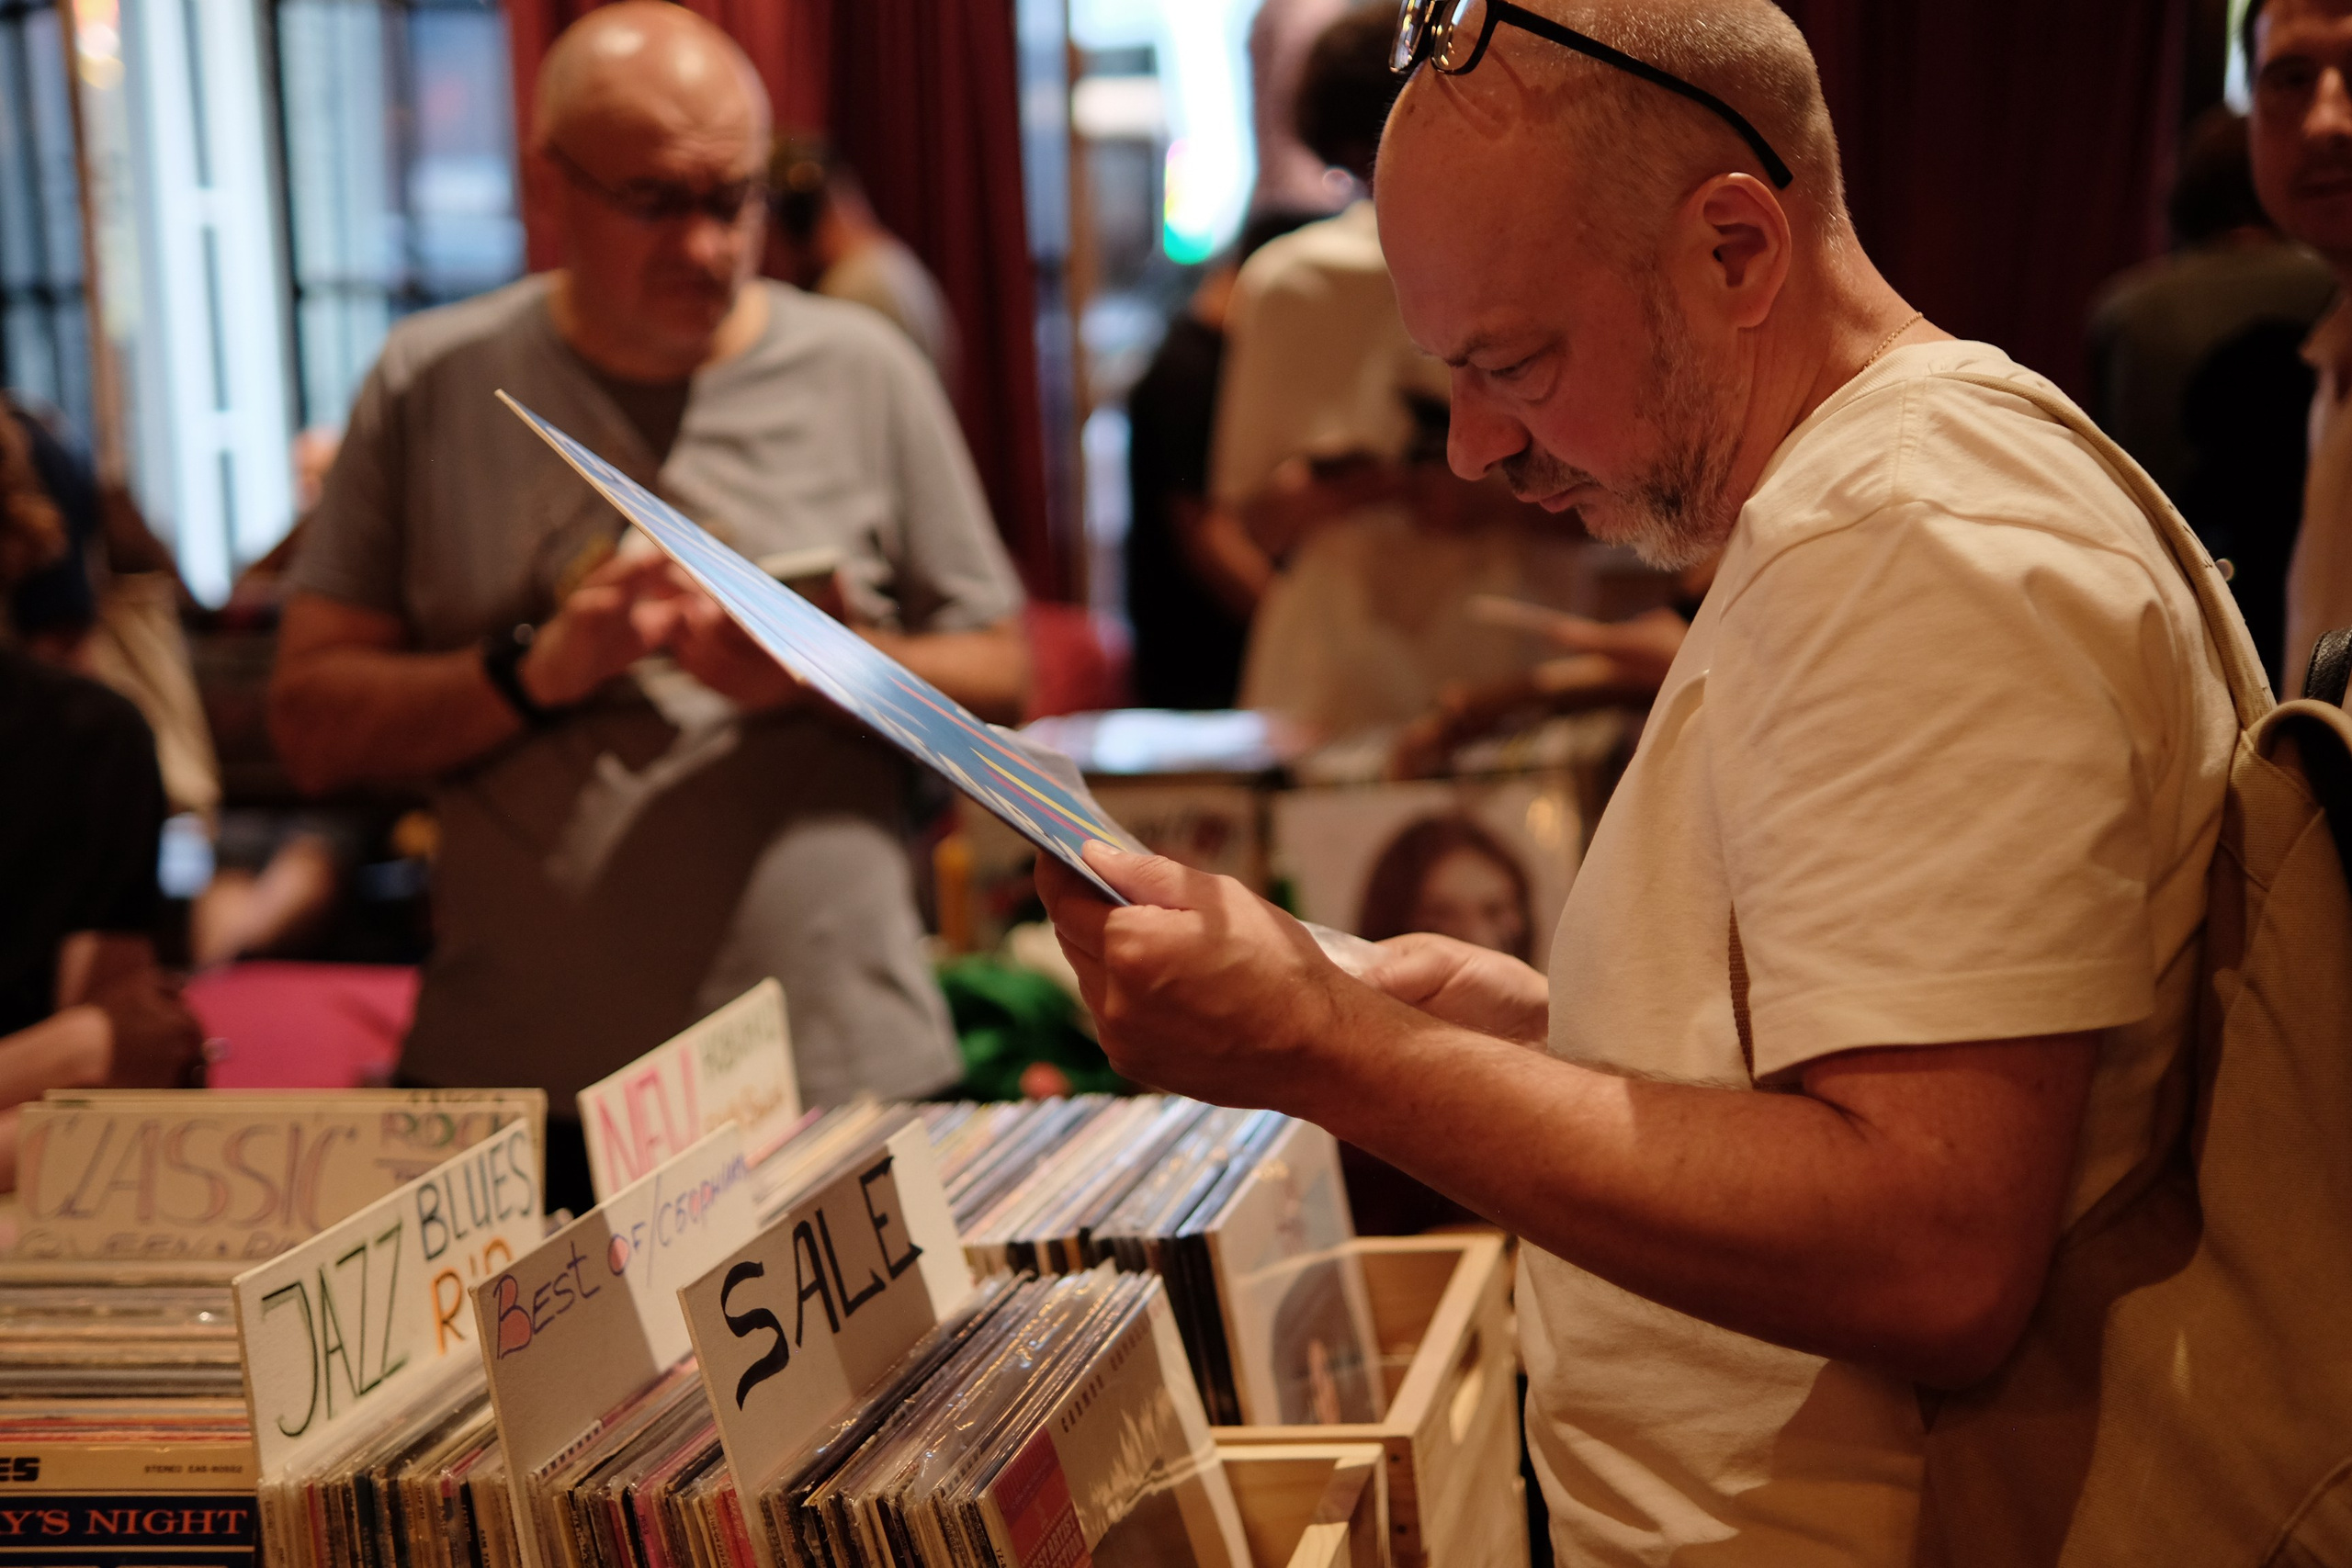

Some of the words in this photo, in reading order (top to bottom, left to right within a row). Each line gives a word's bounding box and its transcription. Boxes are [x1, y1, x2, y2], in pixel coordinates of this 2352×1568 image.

[22, 1114, 358, 1234] CLASSIC
[417, 1130, 533, 1261] BLUES
[261, 1219, 410, 1437] JAZZ
[720, 1156, 923, 1411] SALE
[0, 1509, 70, 1536] Y'S
[85, 1509, 247, 1535] NIGHT
